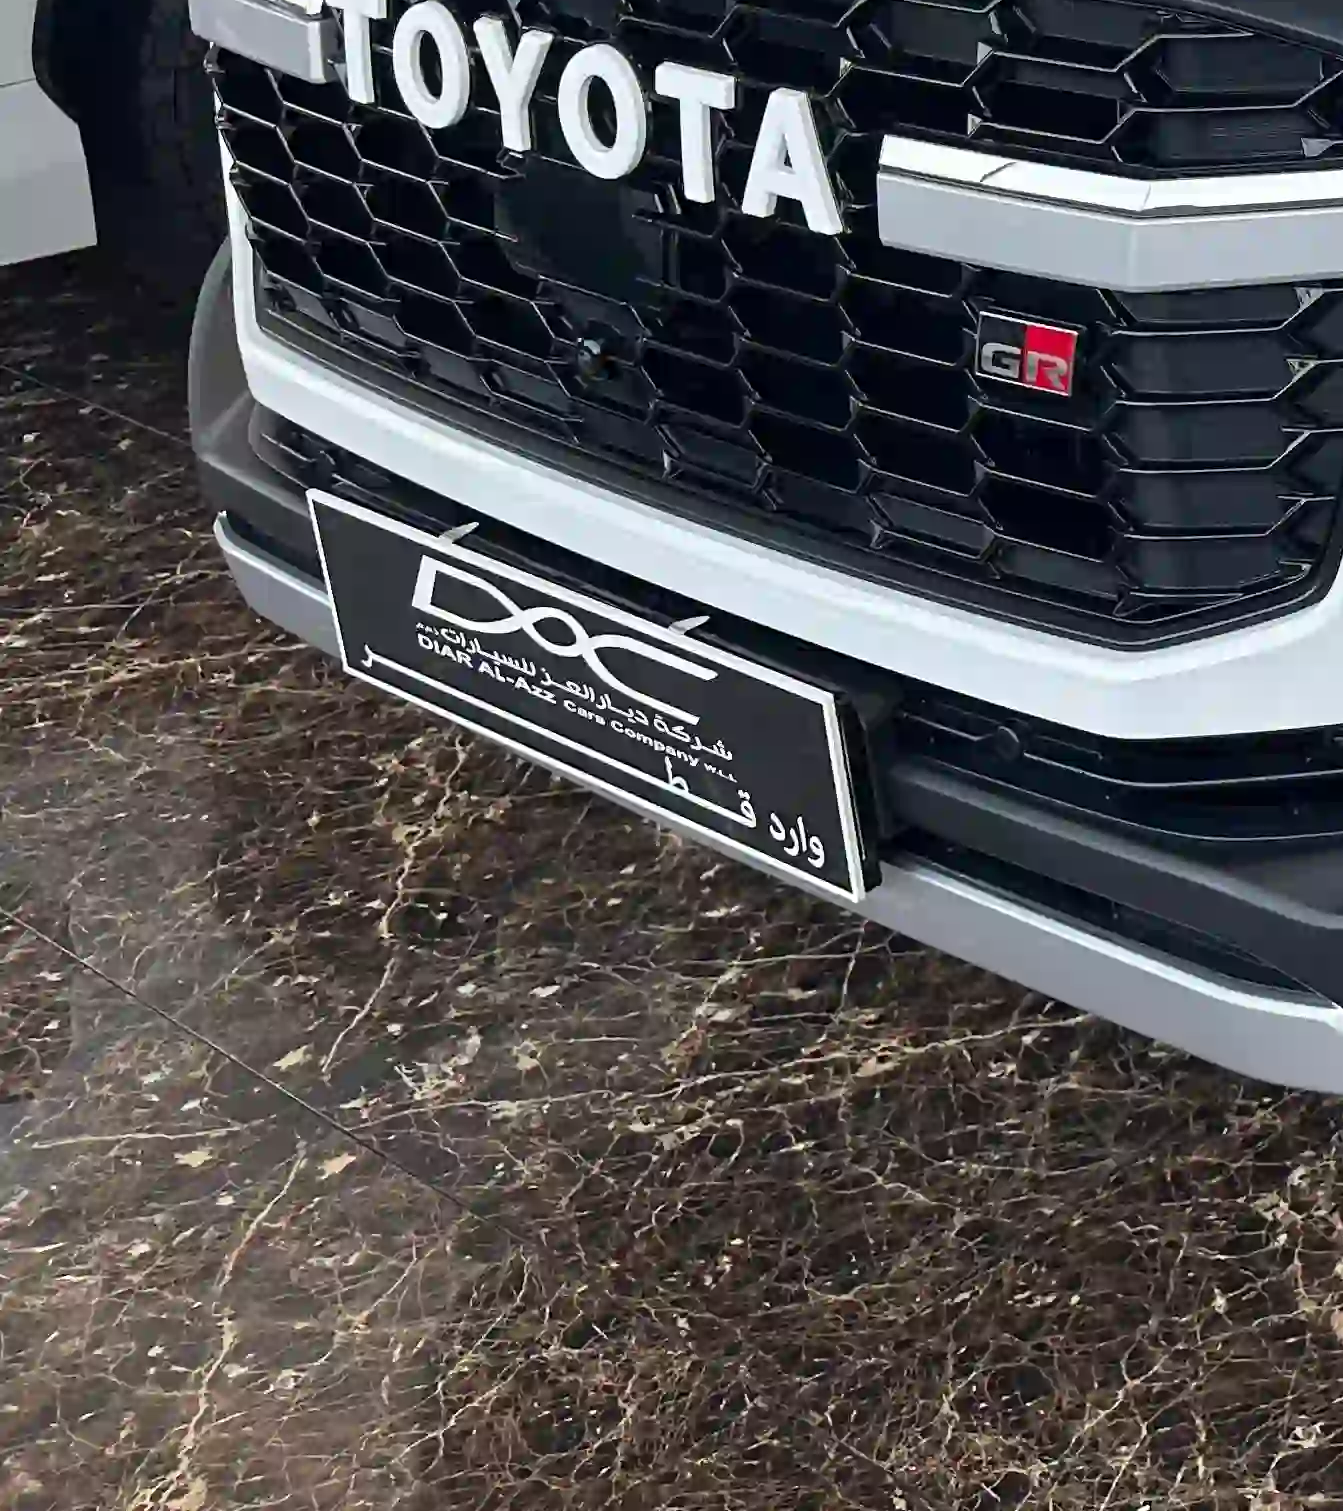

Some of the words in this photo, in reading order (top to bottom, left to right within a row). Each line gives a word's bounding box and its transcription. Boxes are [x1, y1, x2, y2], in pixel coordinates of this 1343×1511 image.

[980, 342, 1069, 391] GR
[440, 628, 537, 677] للسيارات
[417, 633, 474, 668] DIAR
[563, 699, 606, 726] Cars
[610, 720, 700, 767] Company
[540, 667, 596, 703] العز
[595, 693, 650, 726] ديار
[653, 713, 733, 761] شركة
[769, 811, 826, 869] وارد
